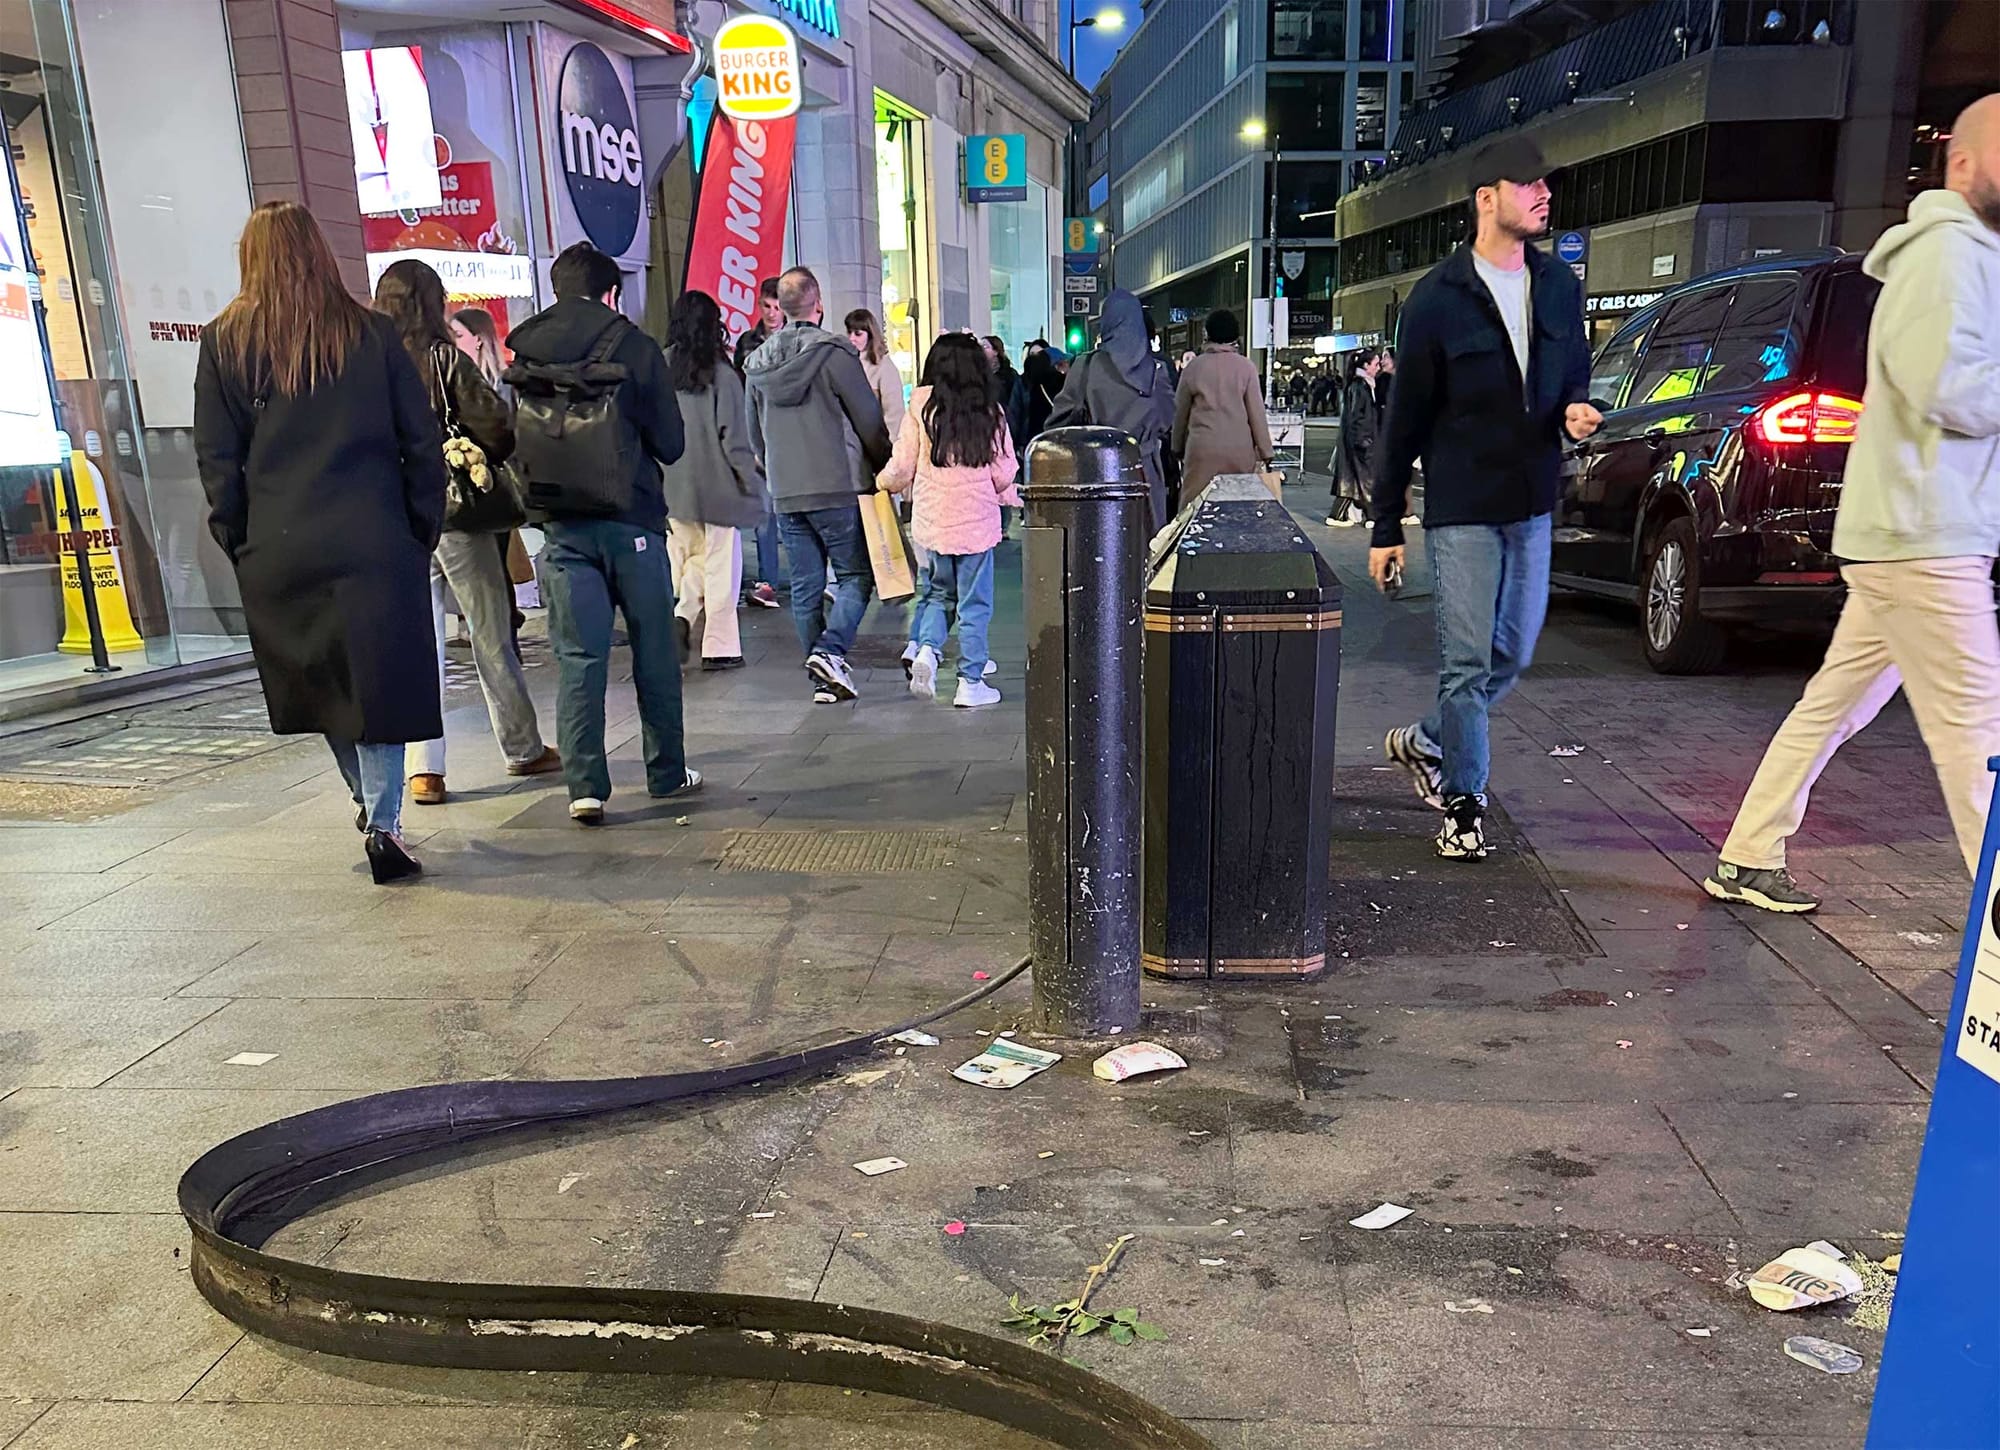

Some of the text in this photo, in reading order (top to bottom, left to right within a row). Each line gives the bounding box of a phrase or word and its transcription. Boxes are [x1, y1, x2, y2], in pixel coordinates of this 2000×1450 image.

[720, 51, 790, 70] BURGER
[723, 70, 792, 96] KING
[562, 110, 643, 187] mse
[718, 118, 768, 347] GER KING
[1586, 292, 1664, 312] ST GILES CASI
[149, 321, 171, 332] HOME
[151, 331, 174, 342] OF THE
[95, 571, 113, 579] WET
[65, 581, 82, 589] FLOO
[1966, 1015, 2000, 1053] STA
